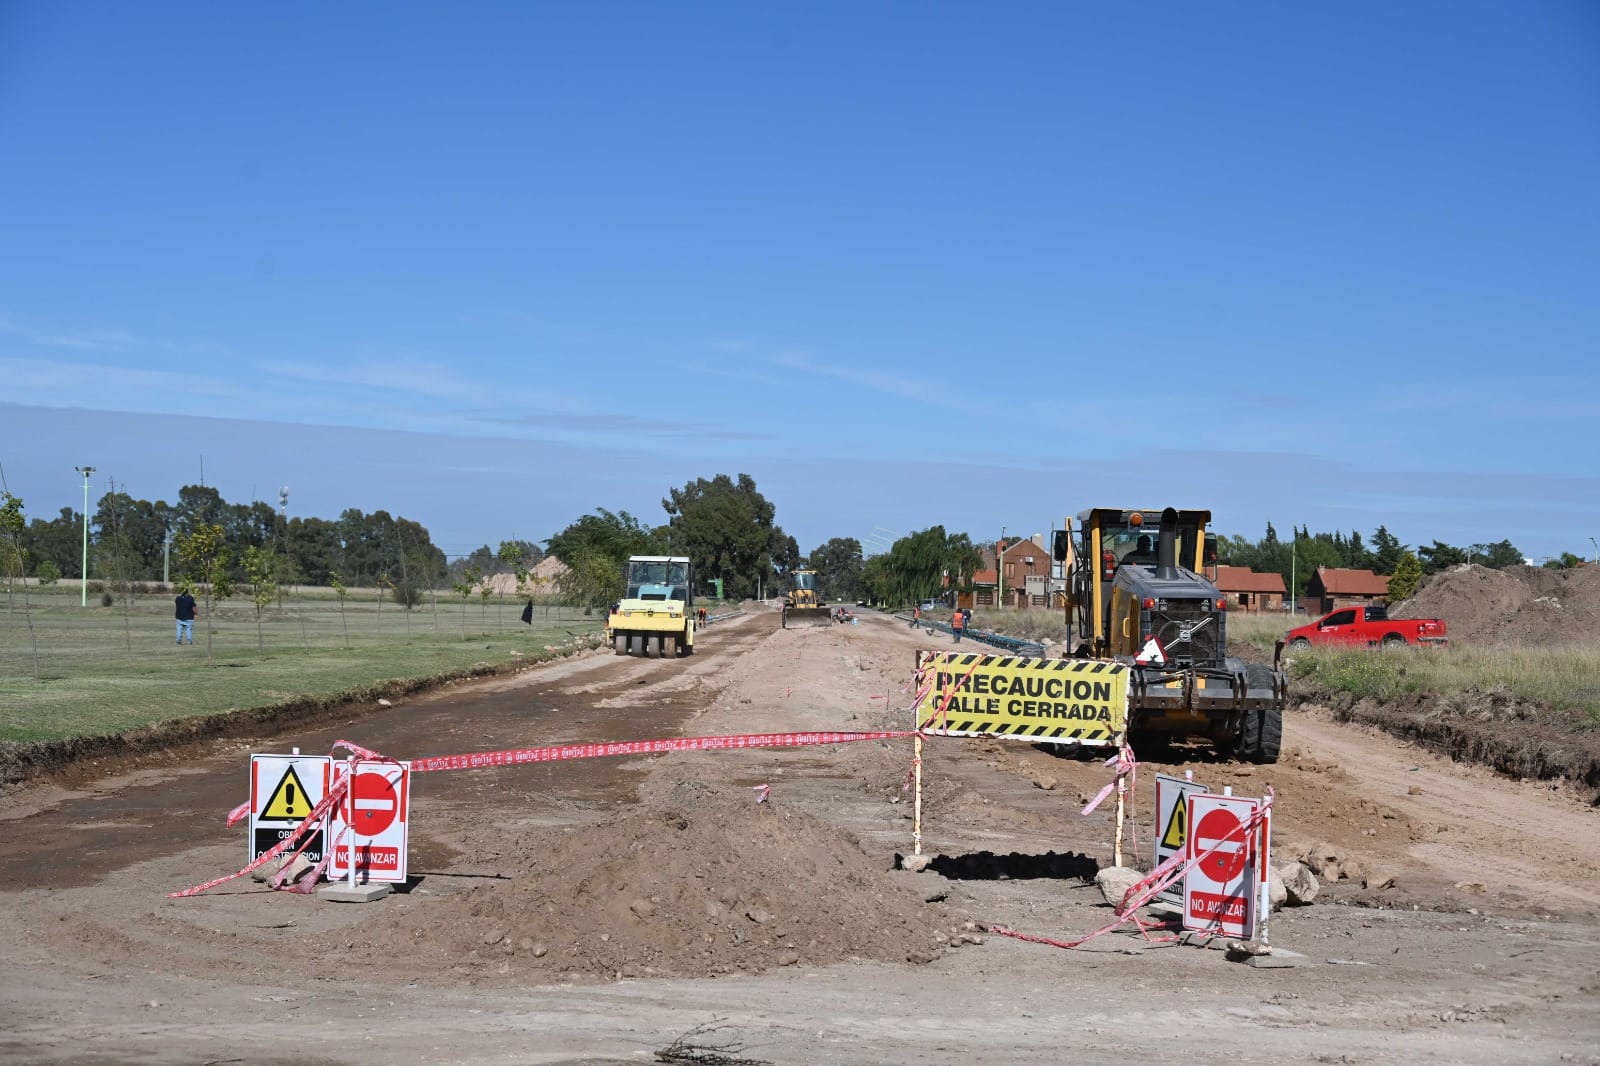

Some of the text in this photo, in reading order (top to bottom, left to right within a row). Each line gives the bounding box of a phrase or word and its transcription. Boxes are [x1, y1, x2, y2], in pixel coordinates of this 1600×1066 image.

[936, 672, 1110, 701] PRECAUCION
[932, 695, 1111, 721] CALLE CERRADA
[355, 852, 396, 864] AVANZAR
[1191, 899, 1246, 917] NO AVANZAR
